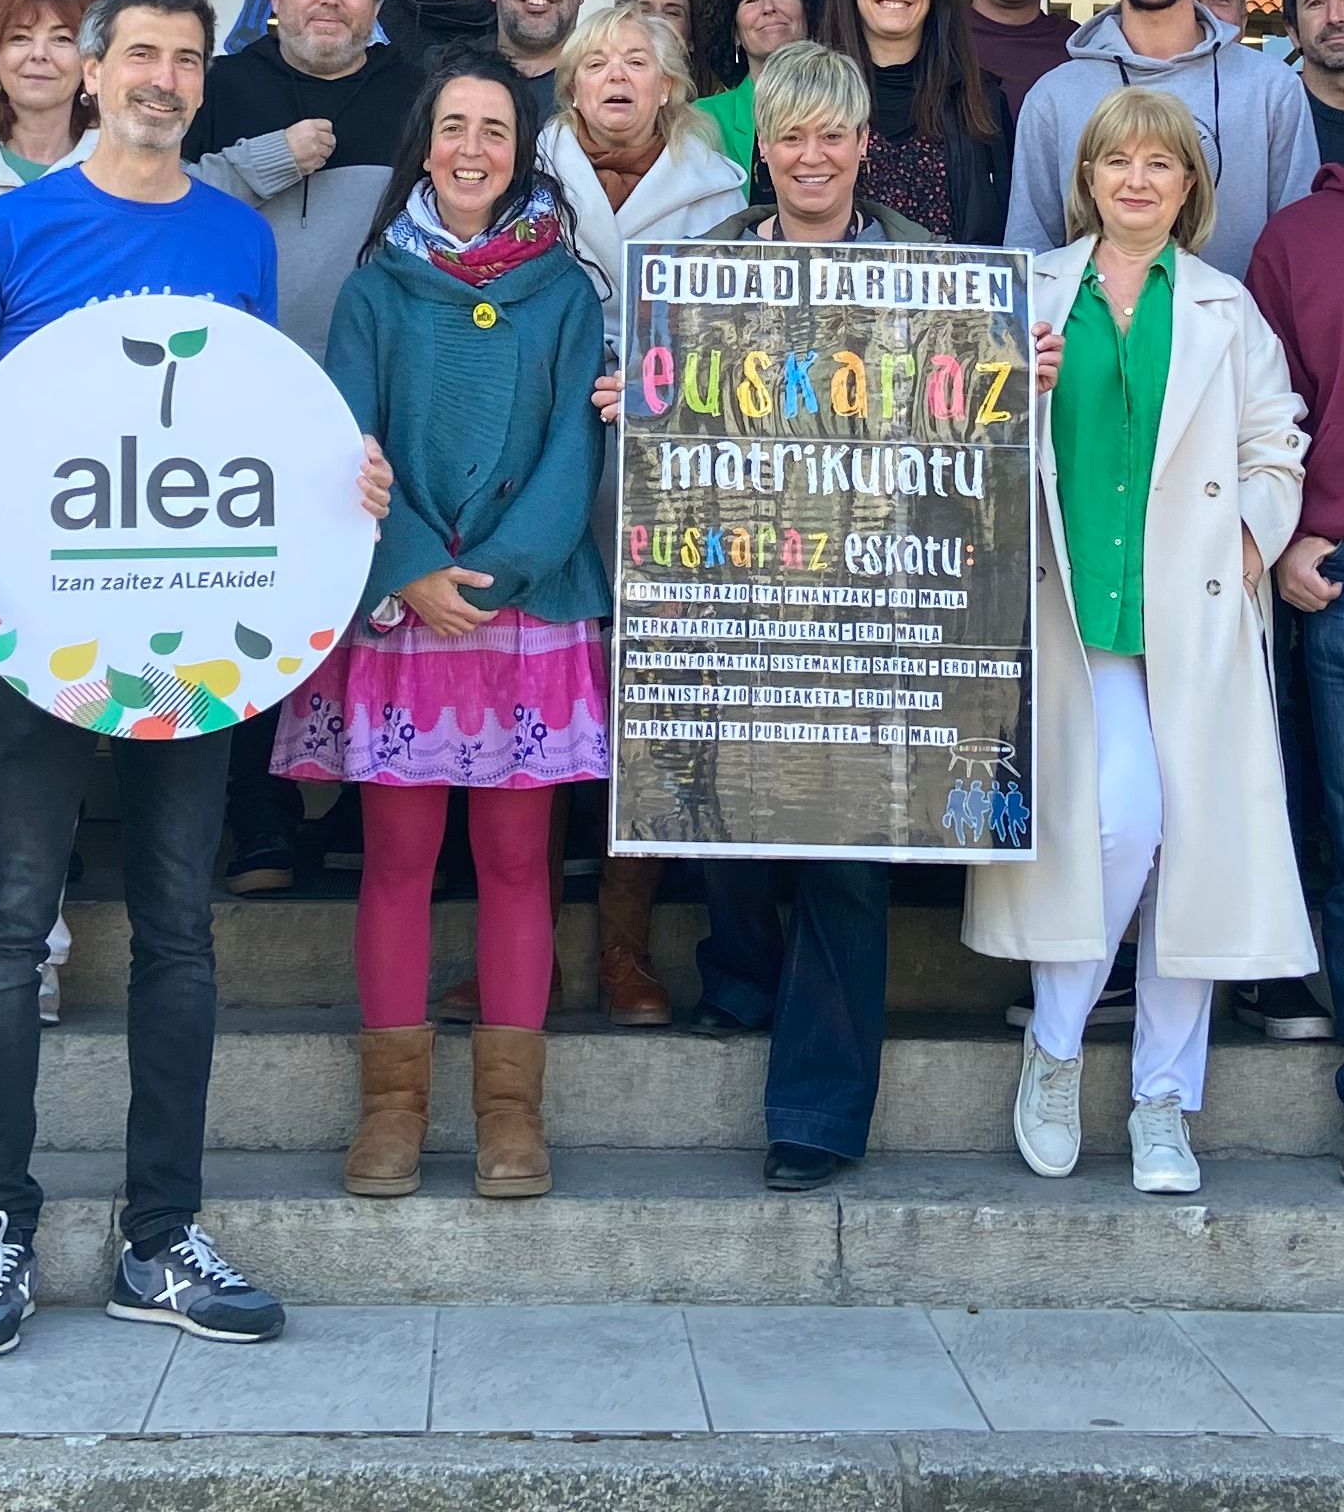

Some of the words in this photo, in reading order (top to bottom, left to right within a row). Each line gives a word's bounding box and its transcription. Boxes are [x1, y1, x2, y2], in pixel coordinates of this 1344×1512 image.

[645, 259, 793, 300] CIUDAD
[816, 265, 1007, 307] JARDINEN
[642, 346, 1012, 425] euskaraz
[660, 440, 984, 499] matrikulatu
[50, 435, 275, 530] alea
[630, 524, 829, 571] euskaraz
[844, 533, 975, 577] eskatu:
[51, 574, 95, 592] Izan
[101, 573, 164, 591] zaitez
[169, 570, 275, 591] ALEAkide!
[628, 584, 748, 601] ADMINISTRAZIO
[755, 586, 779, 600] ETA
[787, 588, 870, 604] FINANTZAK
[891, 591, 914, 606] GOI
[920, 591, 965, 607] MAILA
[628, 619, 743, 636] MERKATARITZA
[752, 622, 837, 639] JARDUERAK
[858, 625, 890, 640] ERDI
[896, 626, 940, 642] MAILA
[627, 652, 766, 669] MIKROINFORMATIKA
[772, 656, 839, 671] SISTEMAK
[846, 658, 868, 672] ETA
[875, 658, 924, 674] SAREAK
[944, 661, 974, 676] ERDI
[980, 661, 1020, 677] MAILA
[626, 687, 747, 702] ADMINISTRAZIO
[858, 691, 890, 707] ERDI
[896, 692, 940, 708] MAILA
[626, 722, 715, 738] MARKETINA
[721, 724, 747, 738] ETA
[881, 728, 904, 743] GOI
[910, 728, 956, 744] MAILA
